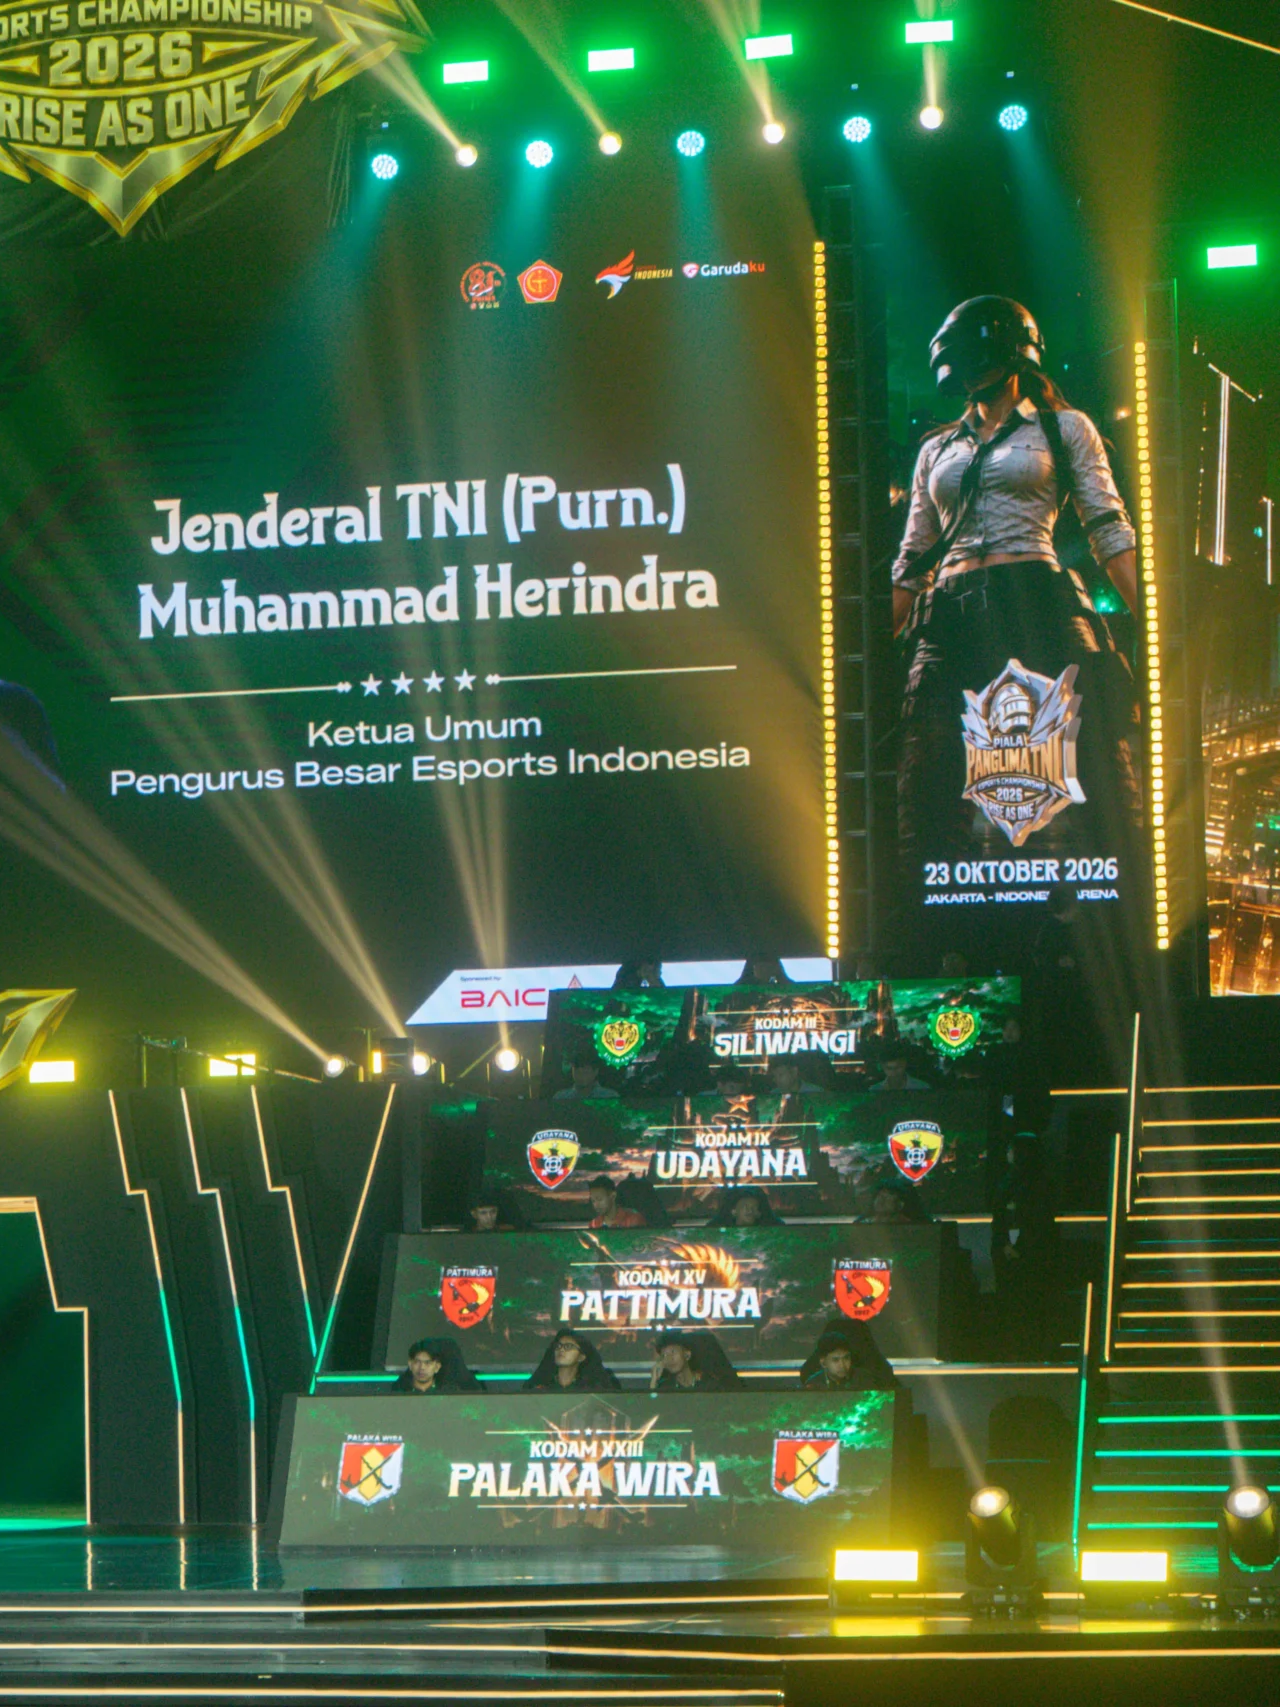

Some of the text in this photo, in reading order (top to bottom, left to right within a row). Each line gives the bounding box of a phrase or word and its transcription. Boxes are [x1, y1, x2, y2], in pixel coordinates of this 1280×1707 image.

[78, 0, 313, 29] CHAMPIONSHIP
[49, 31, 193, 86] 2026
[95, 97, 154, 146] AS
[166, 71, 254, 139] ONE
[634, 268, 673, 280] INDONESIA
[700, 261, 765, 277] Garudaku
[151, 463, 685, 555] Jenderal TNI (Purn.)
[137, 555, 719, 638] Muhammad Herindra
[308, 713, 542, 748] Ketua Umum
[993, 736, 1023, 748] PIALA
[111, 742, 751, 799] Pengurus Besar Esports Indonesia
[966, 743, 1032, 787] PANGLIMA
[996, 787, 1023, 802] 2026
[1005, 806, 1016, 820] AS
[1017, 803, 1034, 819] ONE
[925, 857, 1118, 885] 23 OKTOBER 2026
[925, 893, 986, 904] JAKARTA
[995, 891, 1050, 901] INDONE
[461, 988, 546, 1008] BAIC
[755, 1017, 817, 1030] KODAM III
[714, 1030, 856, 1057] SILIWANGI
[537, 1131, 574, 1140] UDAYANA
[695, 1132, 770, 1147] KODAM IX
[656, 1149, 807, 1178] UDAYANA
[446, 1268, 493, 1277] PATTIMURA
[839, 1260, 887, 1269] PATTIMURA
[618, 1269, 707, 1286] KODAM XV
[560, 1287, 761, 1321] PATTIMURA
[779, 1430, 813, 1438] PALAKA
[530, 1440, 643, 1458] KODAM XXIII
[448, 1461, 721, 1497] PALAKA WIRA
